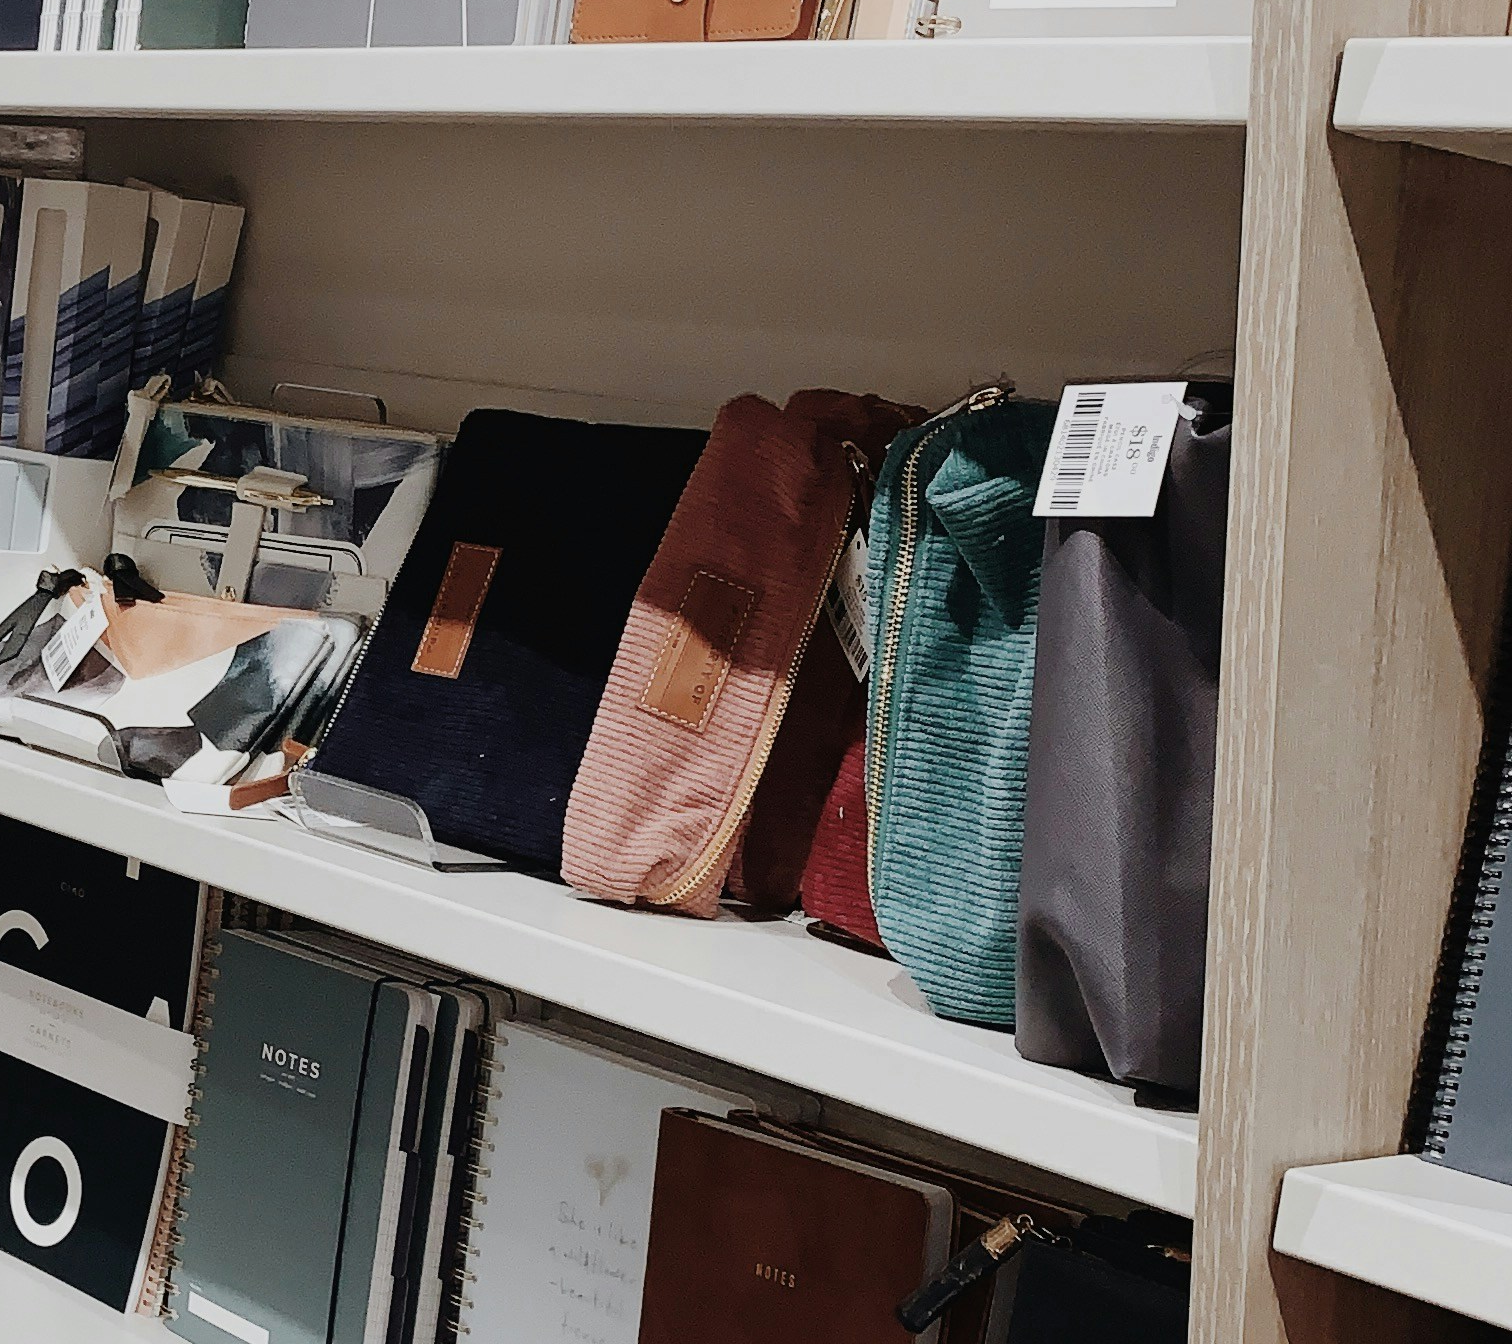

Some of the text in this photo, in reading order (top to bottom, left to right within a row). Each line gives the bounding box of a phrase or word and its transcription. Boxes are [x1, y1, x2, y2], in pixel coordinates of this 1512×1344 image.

[1125, 425, 1149, 460] $18
[1146, 434, 1164, 463] Indigo
[261, 1042, 321, 1079] NOTES
[558, 1201, 585, 1231] She
[755, 1263, 796, 1289] NOTES
